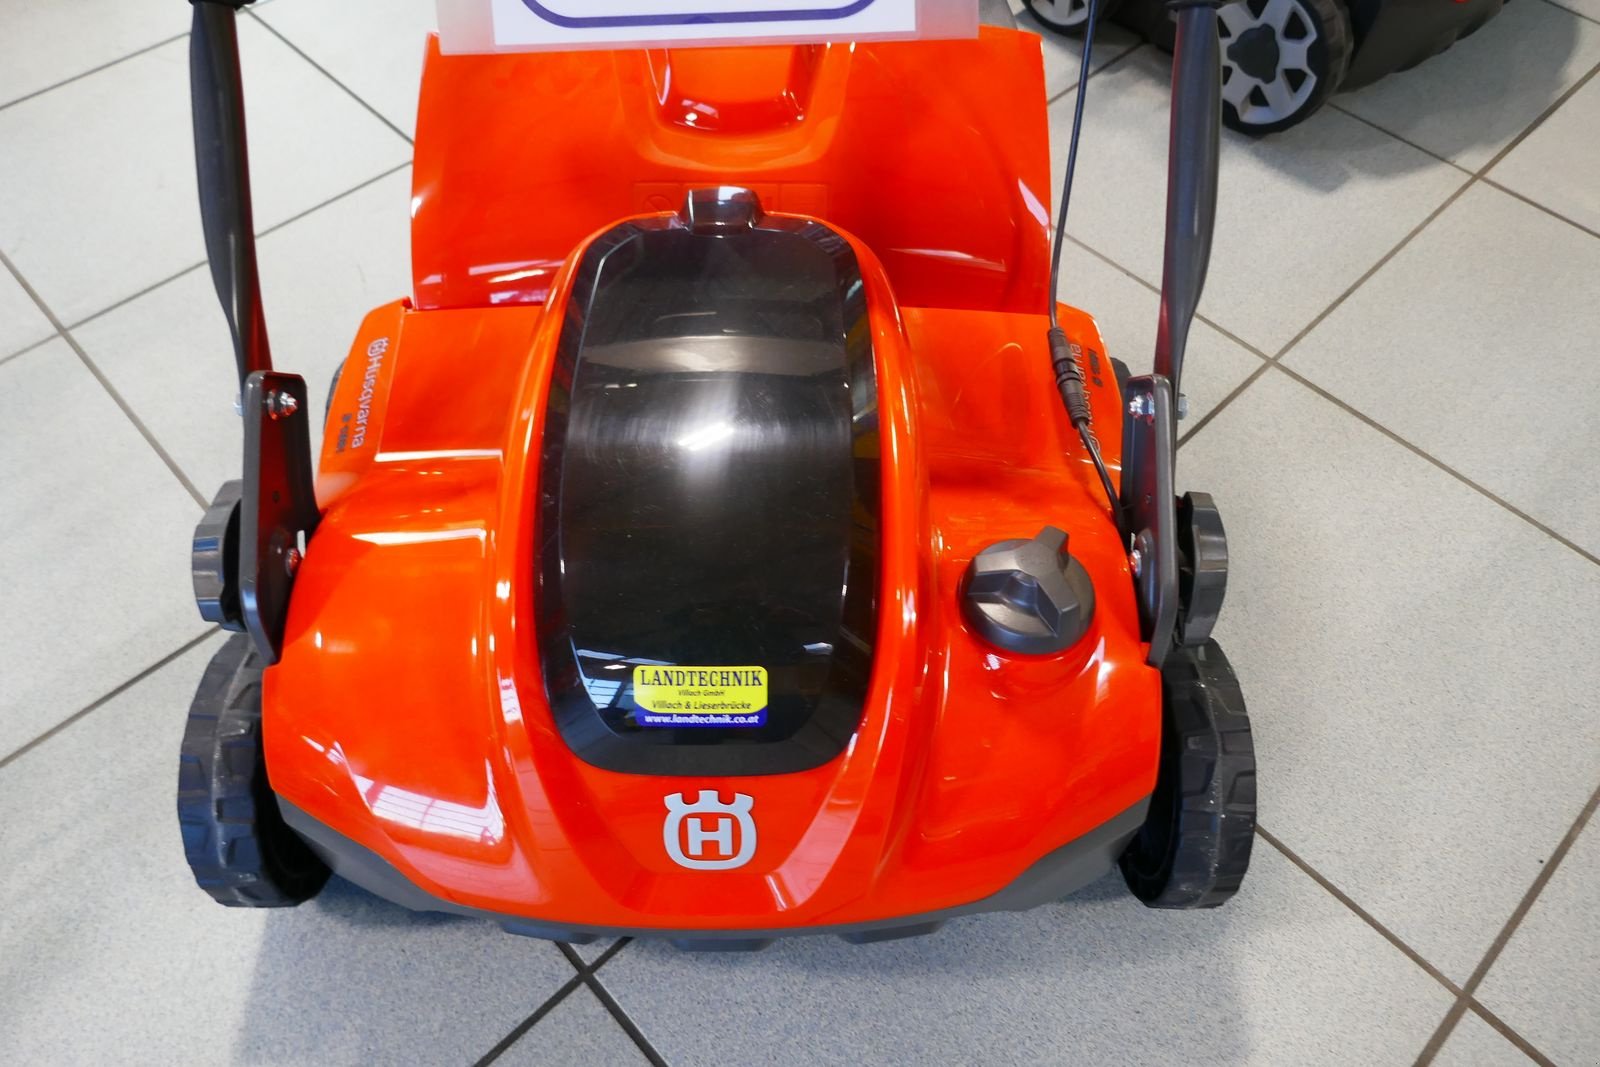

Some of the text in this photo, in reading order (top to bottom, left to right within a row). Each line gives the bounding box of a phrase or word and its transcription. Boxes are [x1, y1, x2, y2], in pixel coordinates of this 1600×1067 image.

[351, 355, 384, 448] Husqvarna
[640, 669, 763, 687] LANDTECHNIK
[678, 689, 725, 697] Villach GmbH
[652, 700, 752, 711] Villach & Lieserbrücke
[644, 714, 760, 724] www.landtechnik.co.at
